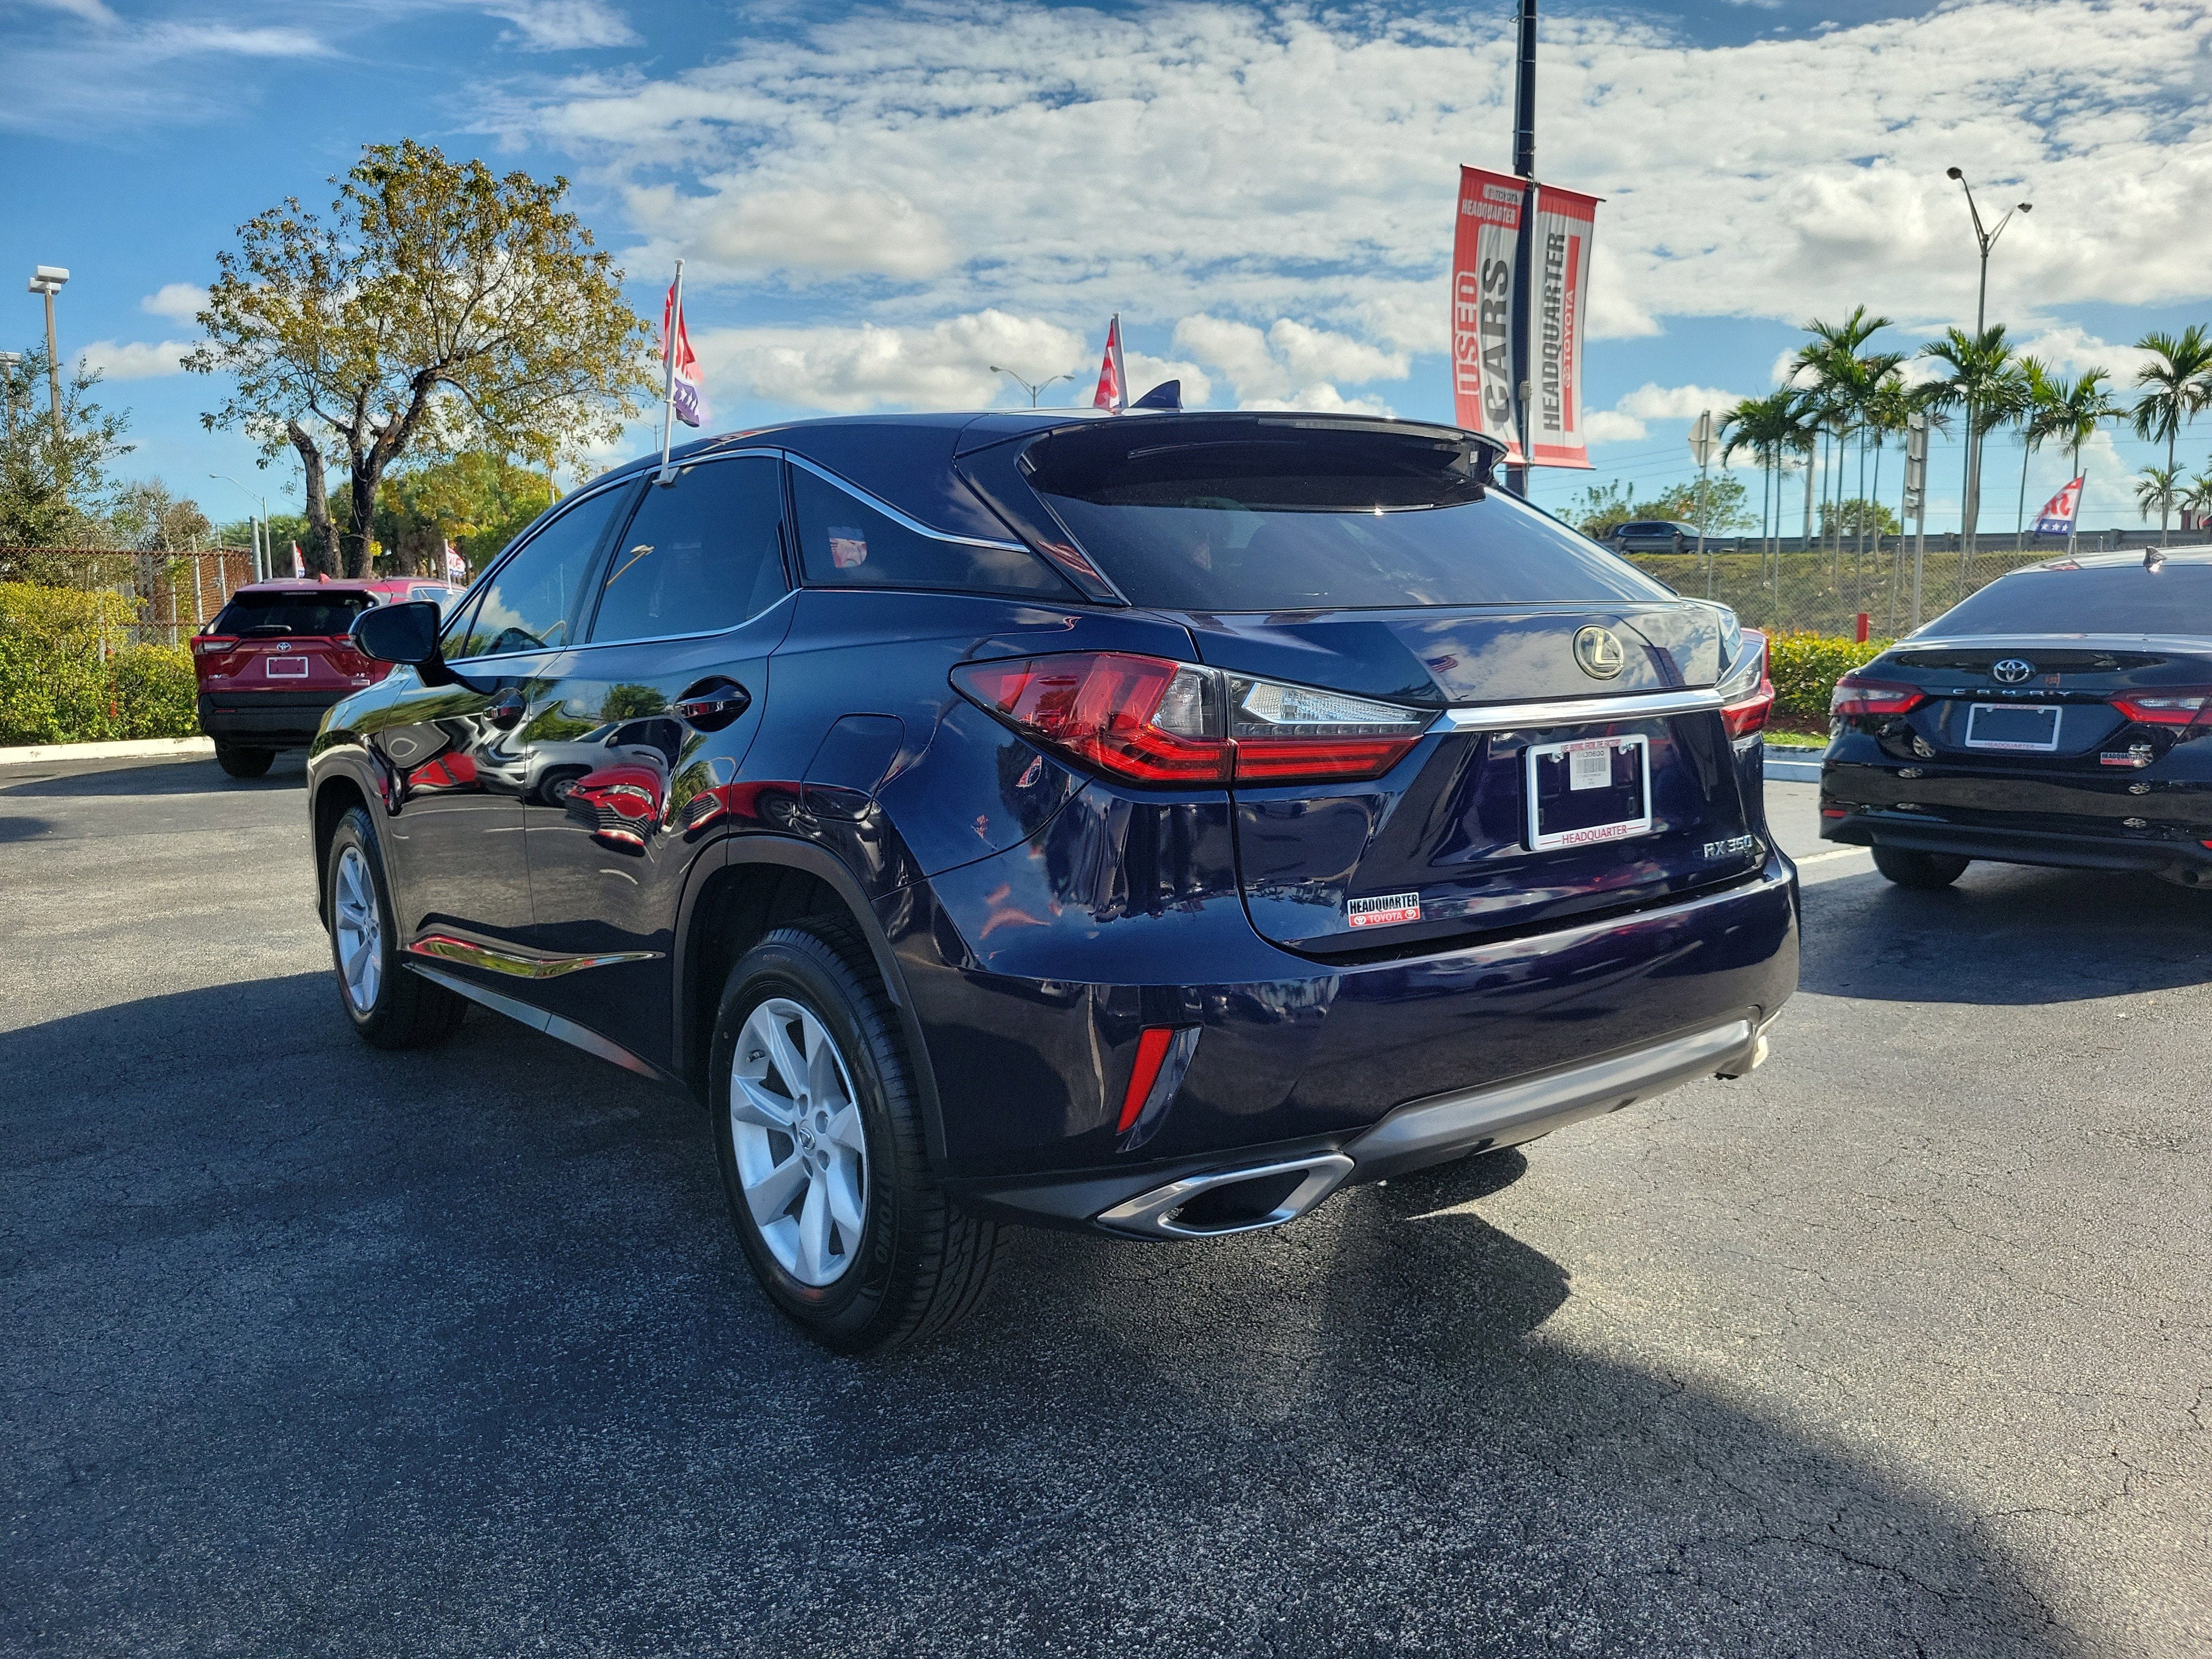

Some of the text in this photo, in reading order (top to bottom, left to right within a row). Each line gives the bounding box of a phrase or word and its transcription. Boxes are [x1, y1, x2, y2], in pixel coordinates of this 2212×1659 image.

[1496, 191, 1517, 202] TOYOTA
[1462, 199, 1516, 224] HEADQUARTER
[1455, 270, 1480, 396] USED
[1482, 258, 1510, 424] CARS
[1543, 233, 1565, 431] HEADQUARTER
[1563, 290, 1575, 367] TOYOTA
[1952, 688, 2073, 696] CAMRY
[1562, 825, 1627, 844] HEADQUARTER
[1703, 834, 1753, 859] RX 350
[1350, 894, 1418, 914] HEADQUARTER
[1368, 912, 1402, 923] TOYOTA
